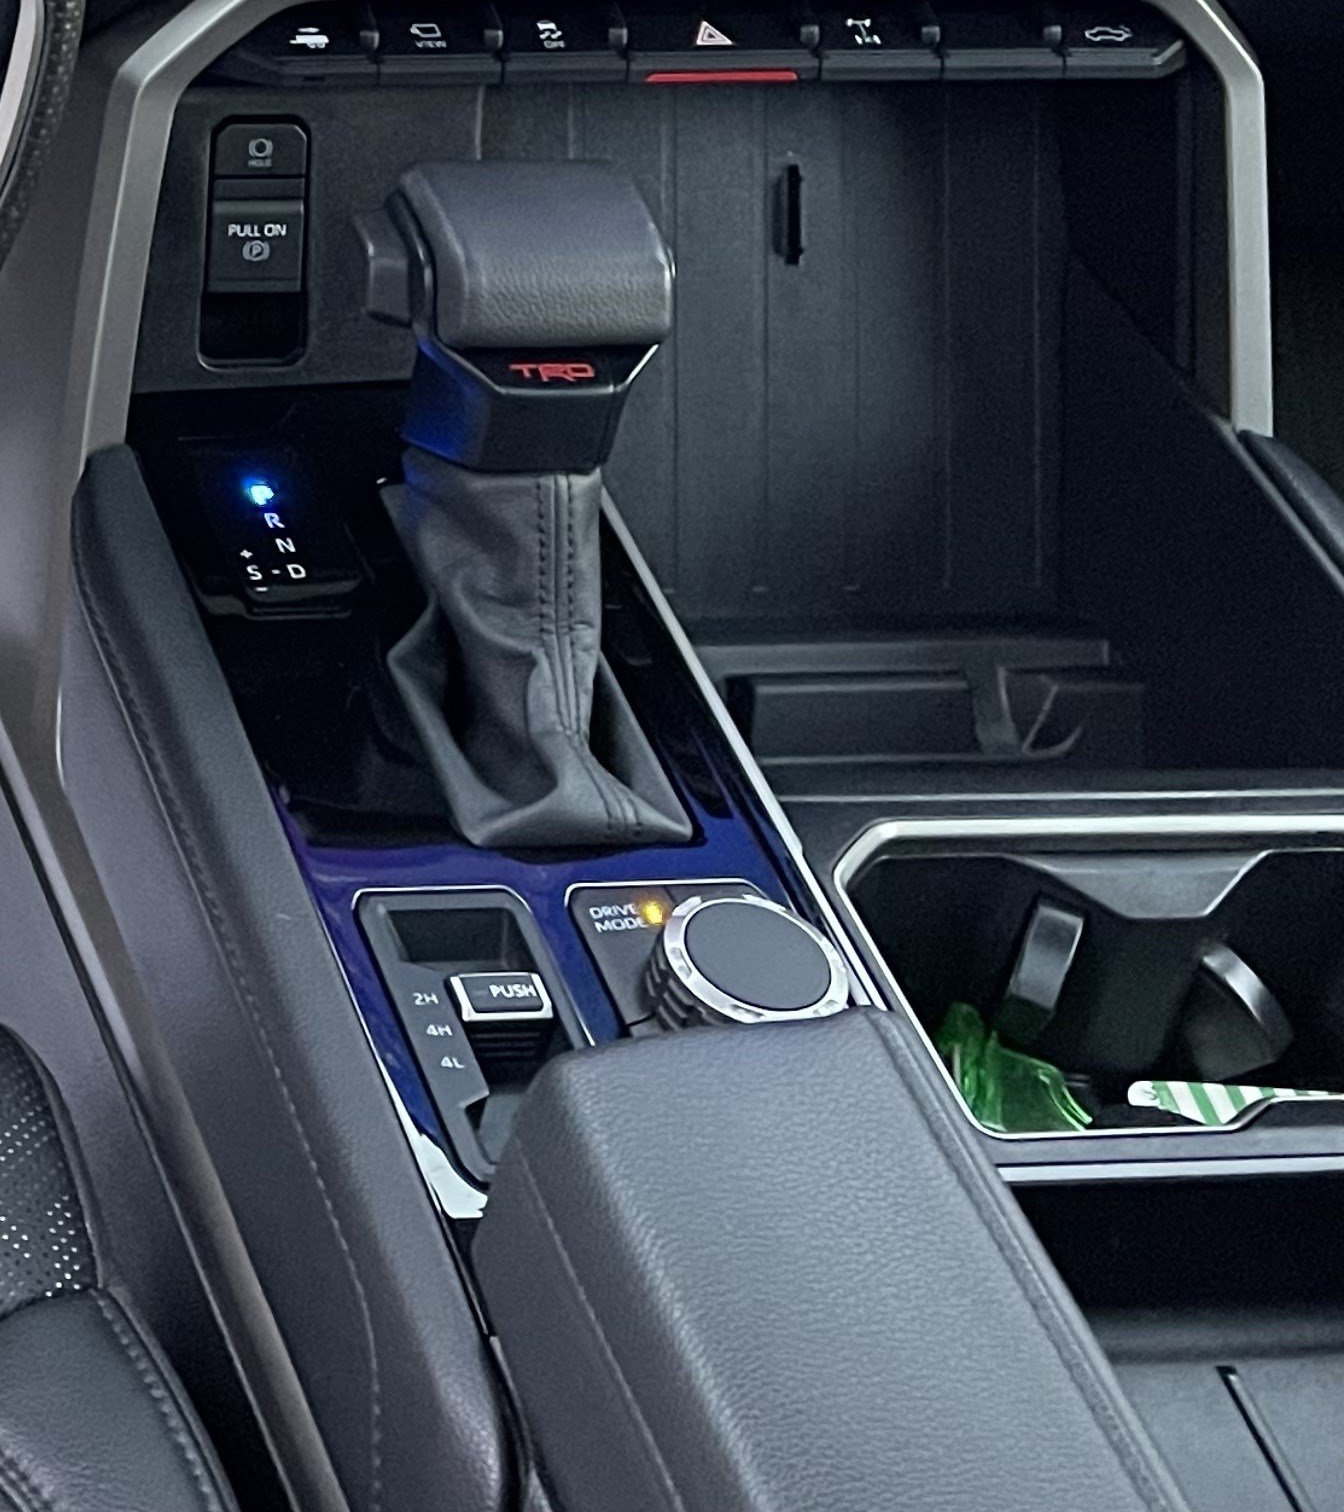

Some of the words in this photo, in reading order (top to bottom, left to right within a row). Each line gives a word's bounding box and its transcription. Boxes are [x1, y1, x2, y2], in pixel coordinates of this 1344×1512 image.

[229, 224, 260, 237] PULL
[264, 224, 286, 236] ON
[510, 364, 594, 381] TRD
[264, 513, 284, 528] R
[276, 538, 295, 553] N
[247, 565, 262, 580] S
[287, 564, 305, 578] D
[589, 904, 639, 920] DRIVE
[594, 917, 649, 932] MODE
[489, 984, 535, 998] PUSH
[413, 993, 438, 1005] 2H
[427, 1025, 452, 1035] 4H
[441, 1057, 464, 1068] 4L
